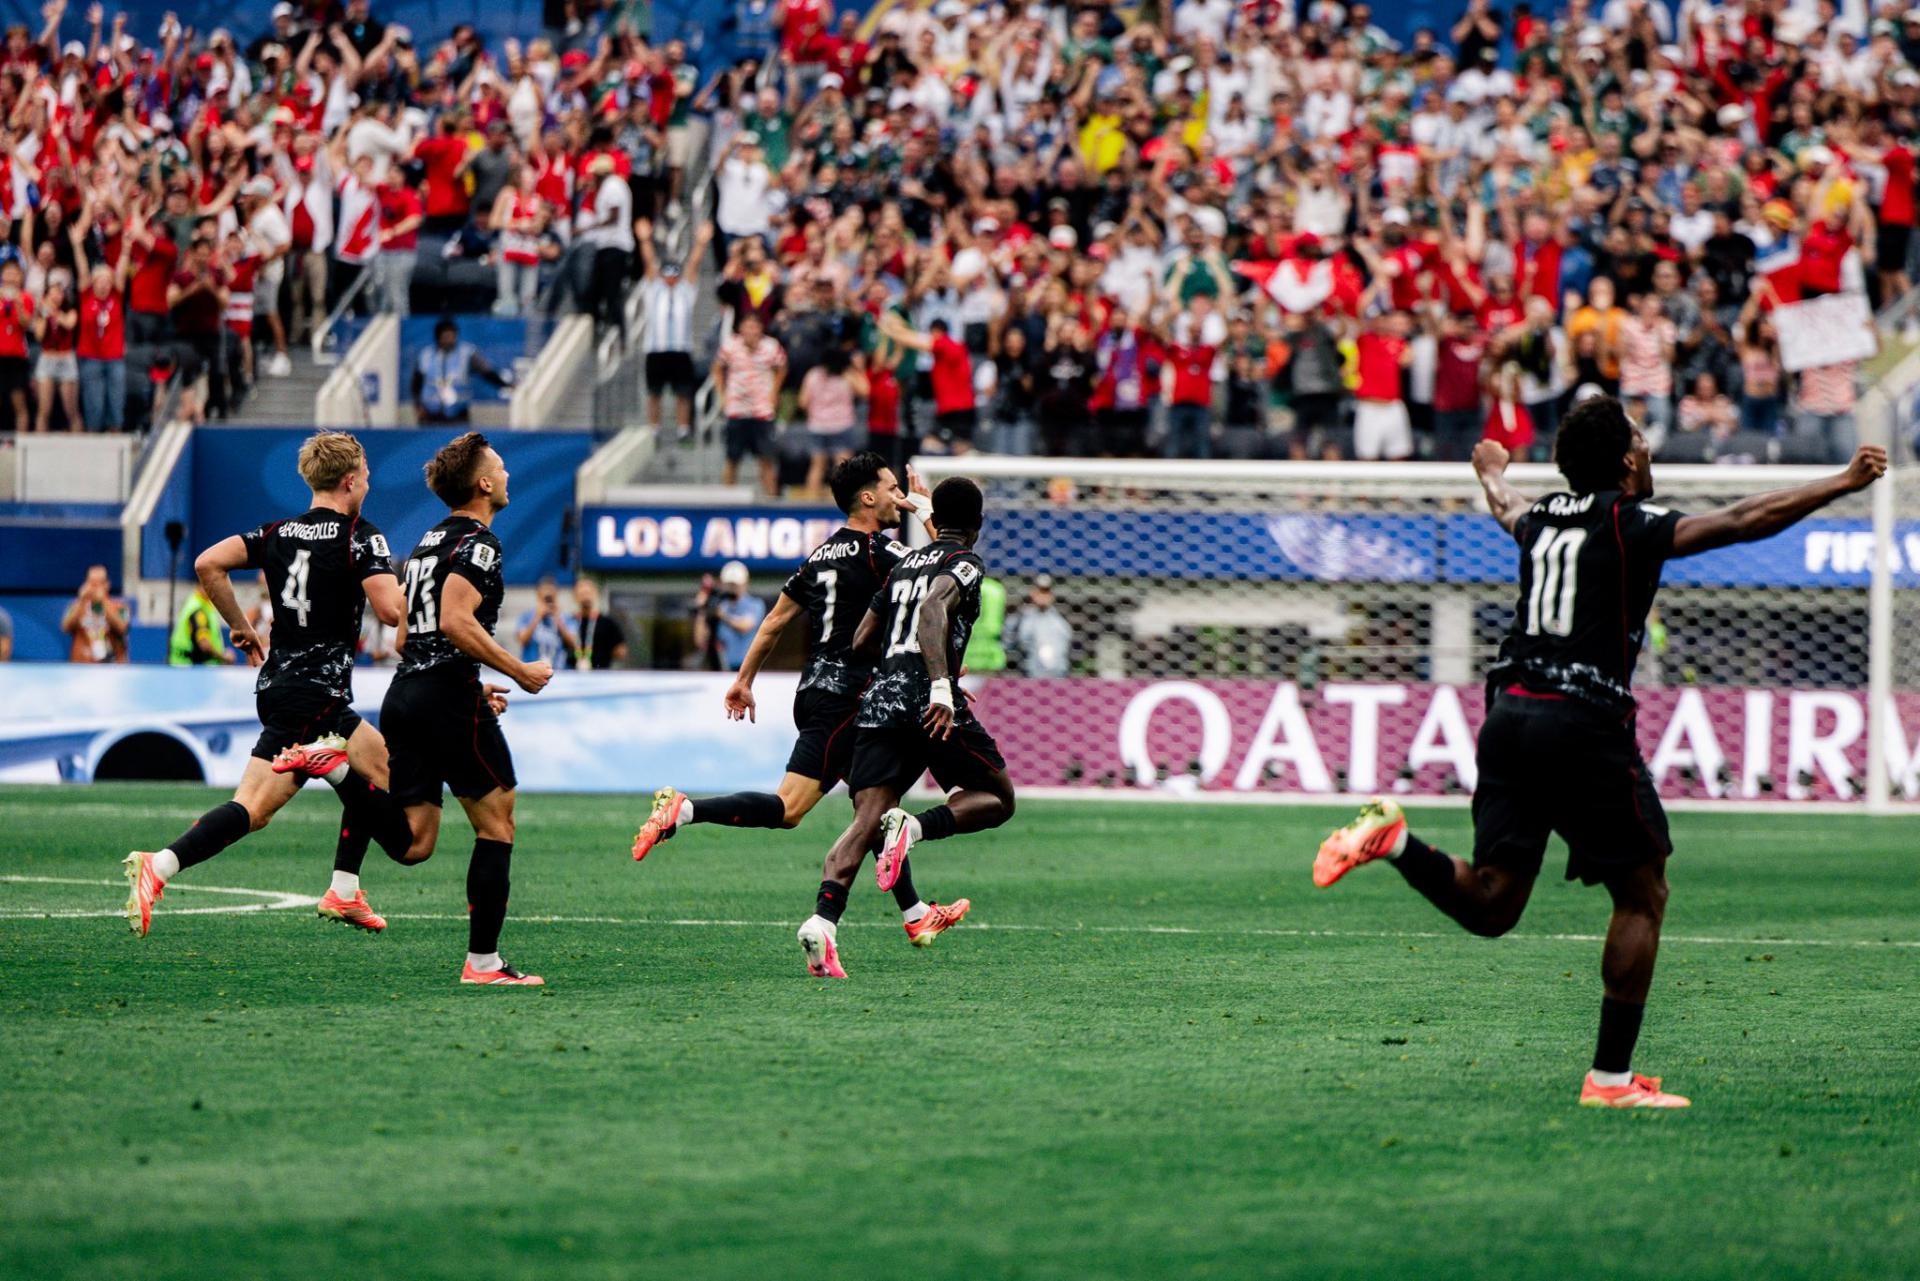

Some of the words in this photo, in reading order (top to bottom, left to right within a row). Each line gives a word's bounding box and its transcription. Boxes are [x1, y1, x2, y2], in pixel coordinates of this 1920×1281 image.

[597, 516, 693, 557] LOS
[702, 517, 849, 559] ANGE
[281, 549, 312, 627] 4
[405, 556, 439, 634] 23
[816, 570, 838, 643] 7
[886, 574, 929, 659] 22
[1526, 526, 1587, 637] 10
[1118, 680, 1477, 795] QATA
